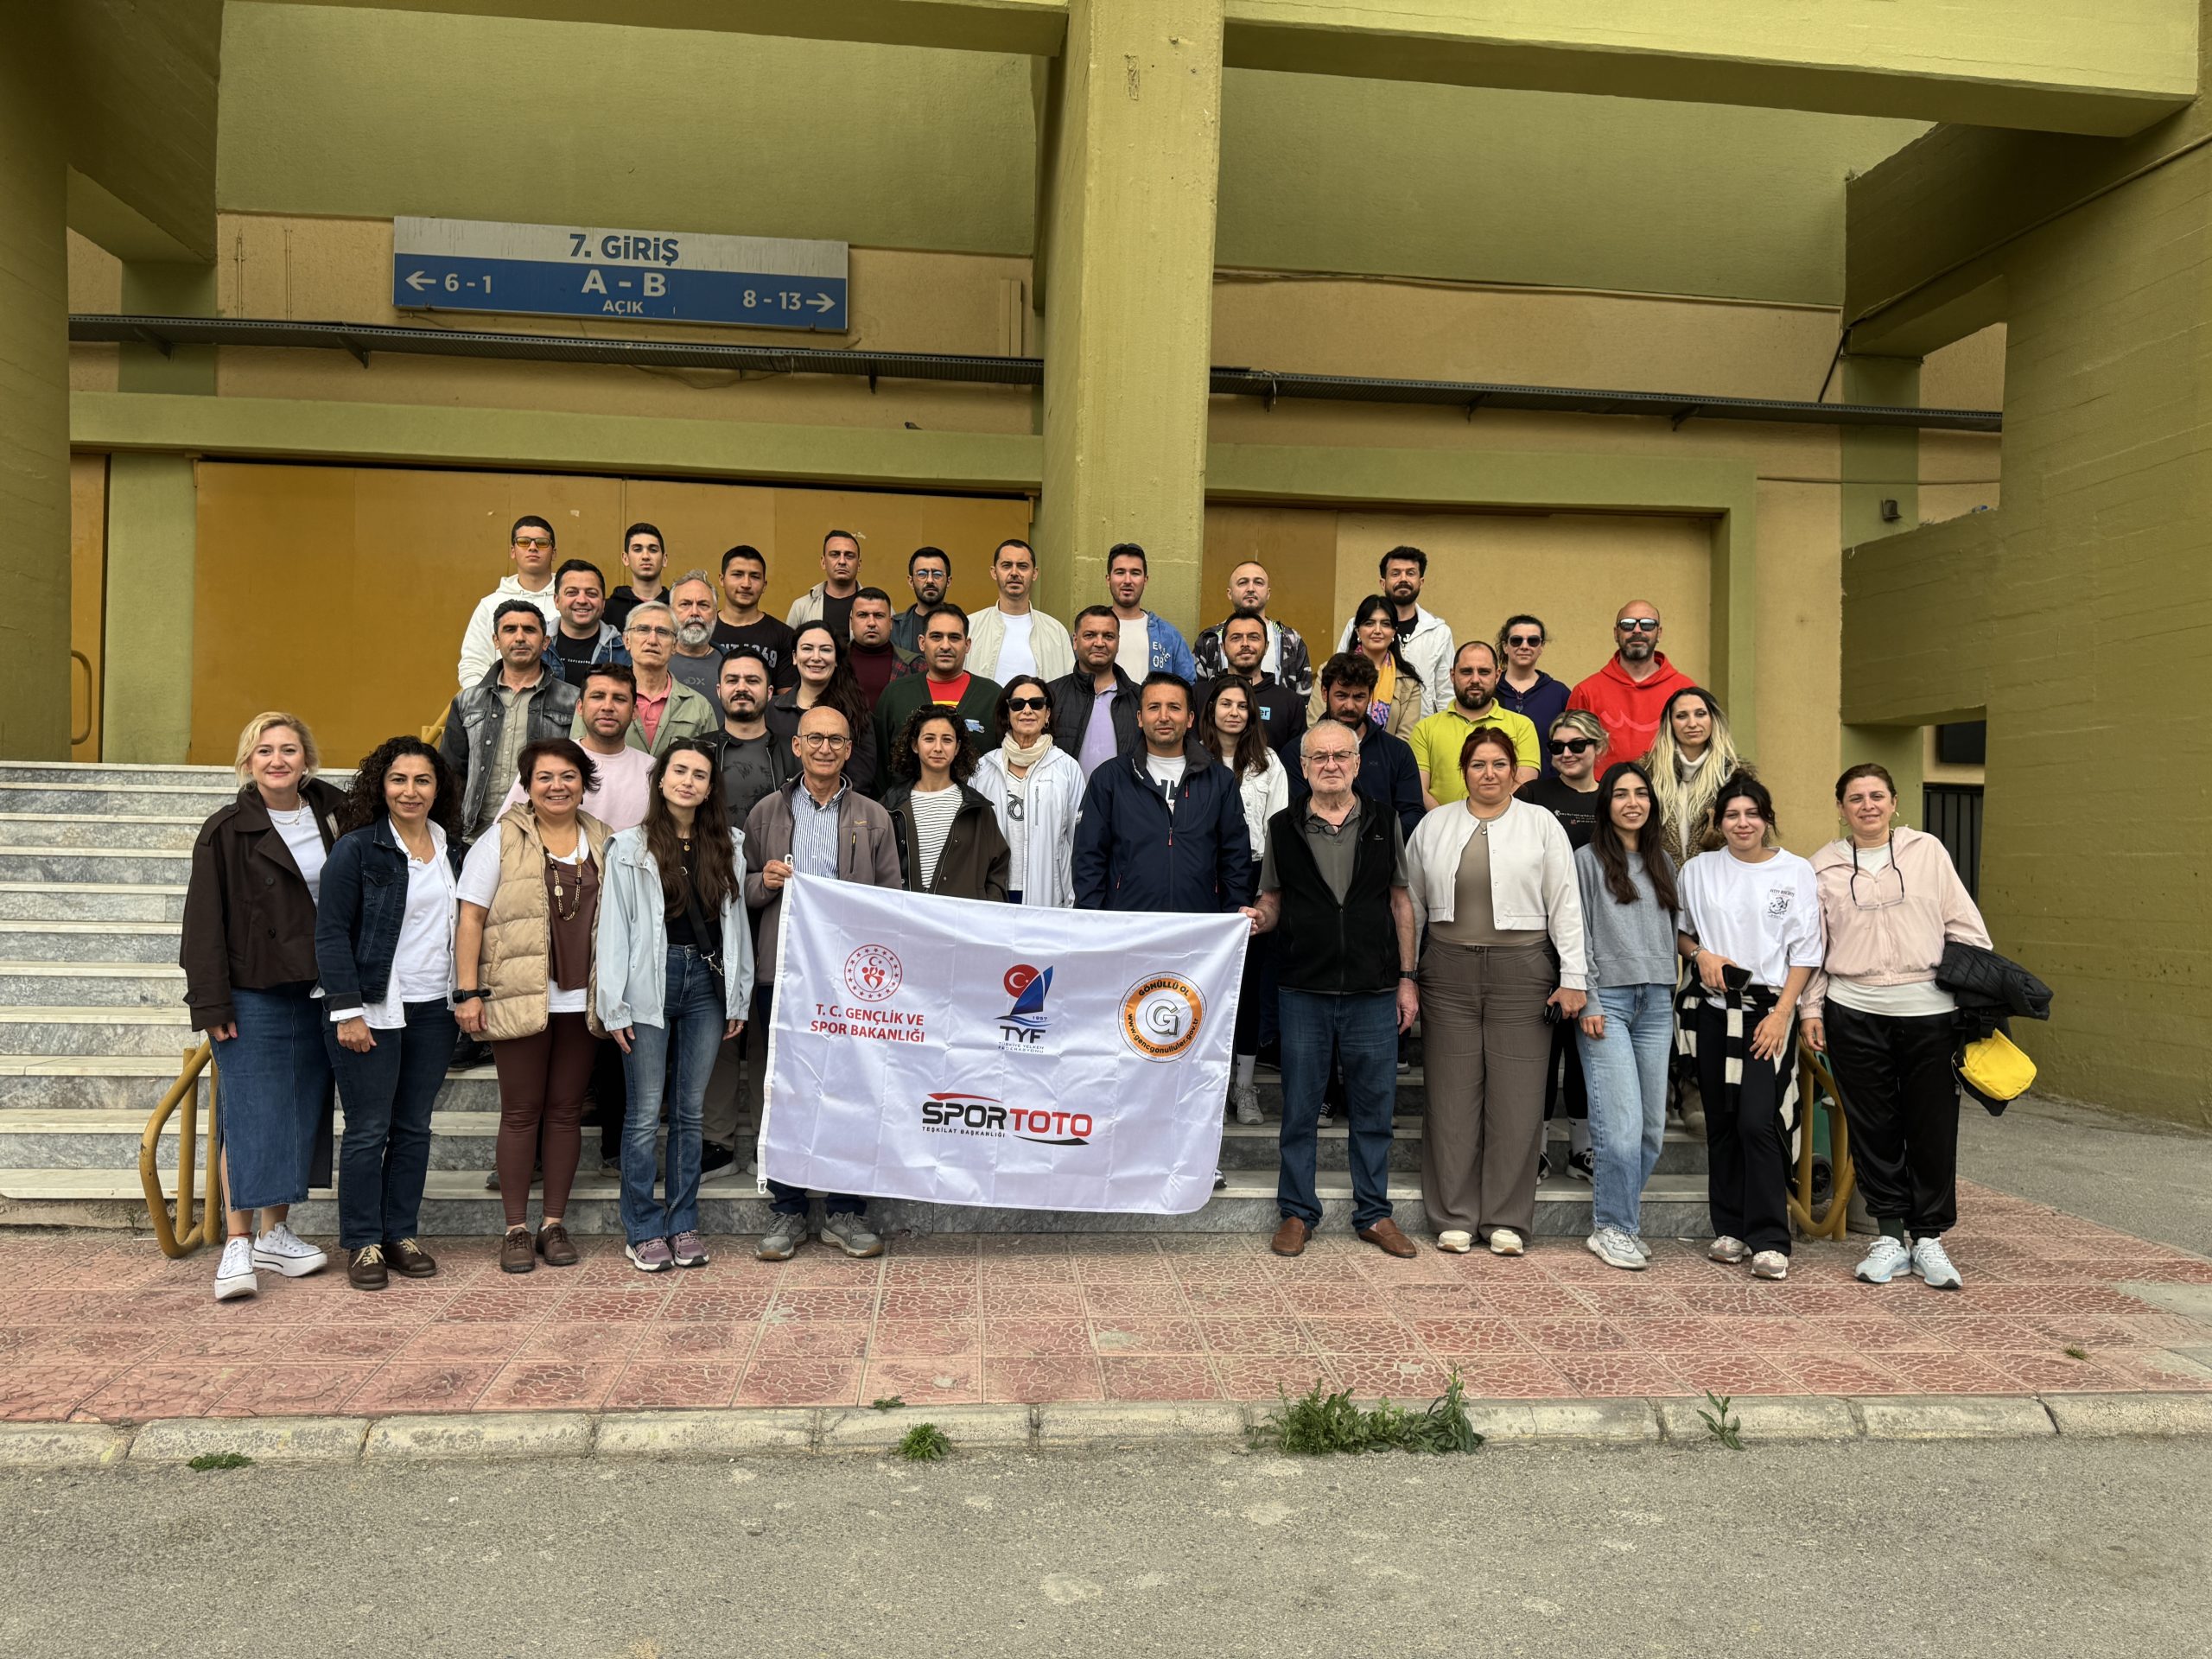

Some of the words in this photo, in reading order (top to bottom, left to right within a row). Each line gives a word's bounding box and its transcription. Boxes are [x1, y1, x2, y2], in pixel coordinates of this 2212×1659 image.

[569, 233, 592, 257] 7.
[444, 273, 460, 292] 6
[483, 276, 492, 294] 1
[581, 269, 607, 295] A
[643, 271, 666, 297] B
[602, 299, 644, 315] AÇIK
[743, 289, 757, 308] 8
[779, 291, 802, 311] 13
[1138, 979, 1179, 996] GÖNÜLLÜ
[1179, 986, 1191, 997] OL
[816, 1003, 826, 1016] T.
[829, 1005, 842, 1018] C.
[845, 1007, 905, 1026] GENÇLİK
[906, 1014, 925, 1026] VE
[810, 1020, 848, 1035] SPOR
[850, 1025, 925, 1043] BAKANLIĞI
[999, 1025, 1046, 1044] TYF
[1127, 1013, 1199, 1054] www.gencgonulluler.gov.tr
[960, 1129, 1006, 1138] BAŞKANLIĞI
